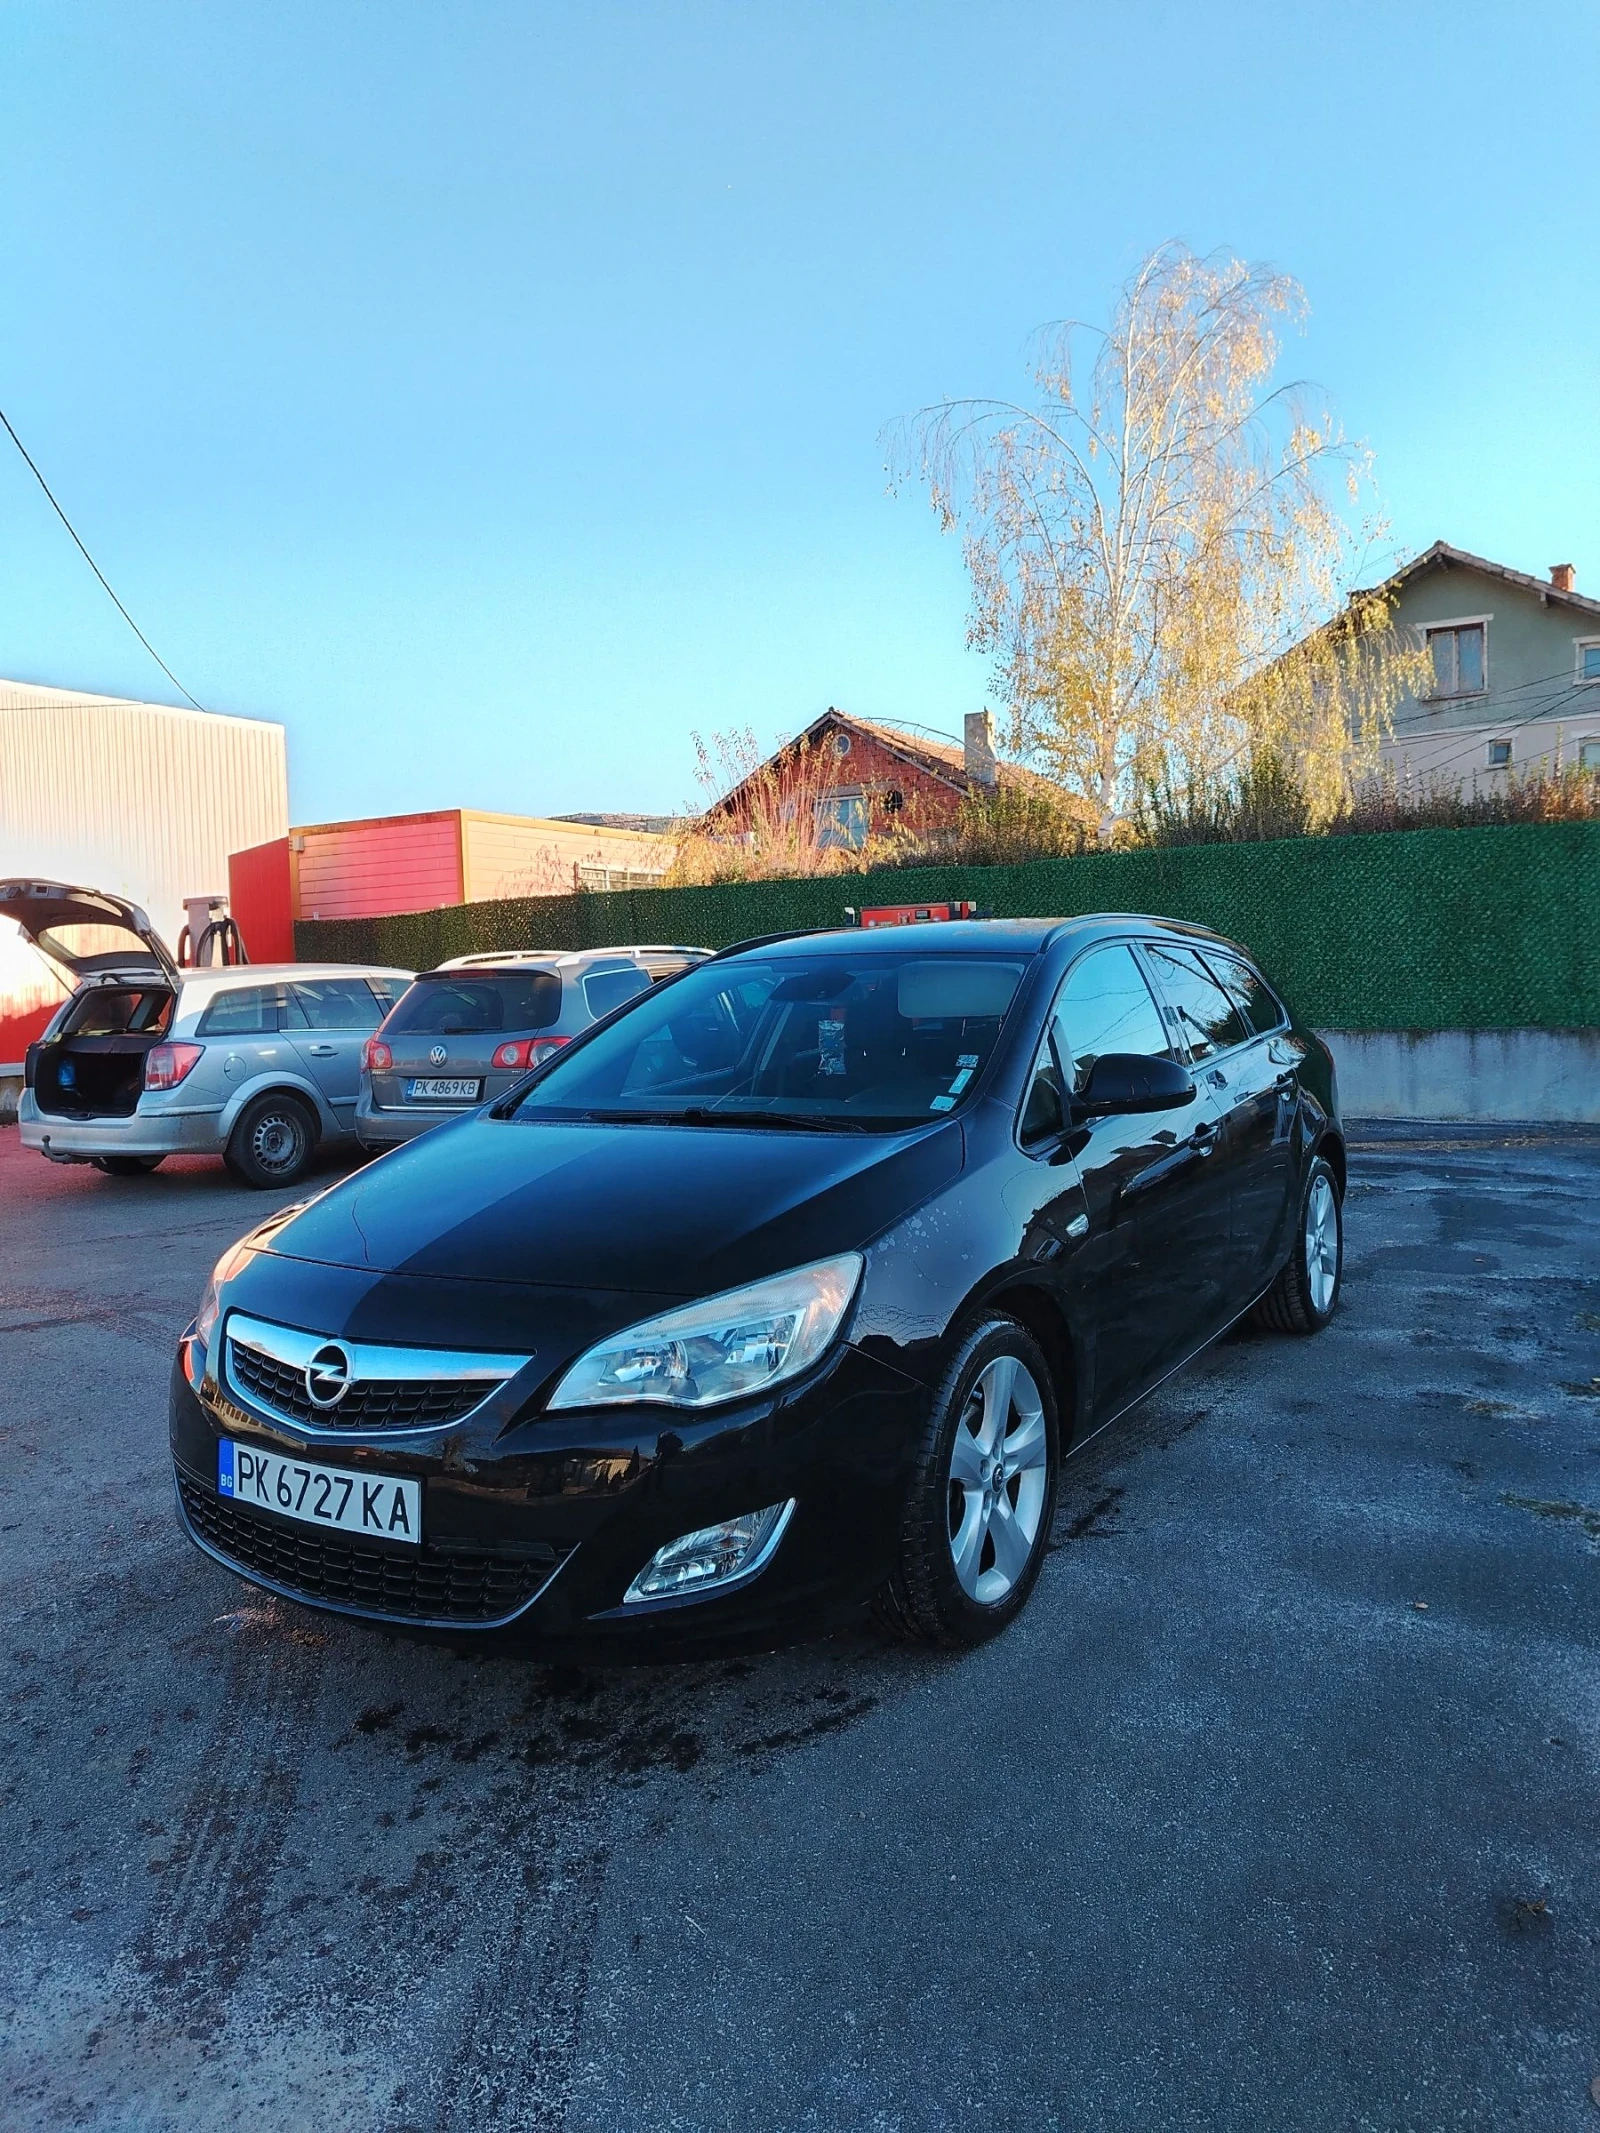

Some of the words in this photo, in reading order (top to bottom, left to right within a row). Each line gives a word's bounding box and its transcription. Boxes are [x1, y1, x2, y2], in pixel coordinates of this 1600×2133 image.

[414, 1081, 430, 1095] PK
[431, 1081, 459, 1095] 4869
[460, 1081, 476, 1095] KB
[221, 1473, 233, 1488] BG
[237, 1450, 270, 1503] PK
[276, 1464, 354, 1521] 6727
[362, 1481, 411, 1535] KA
